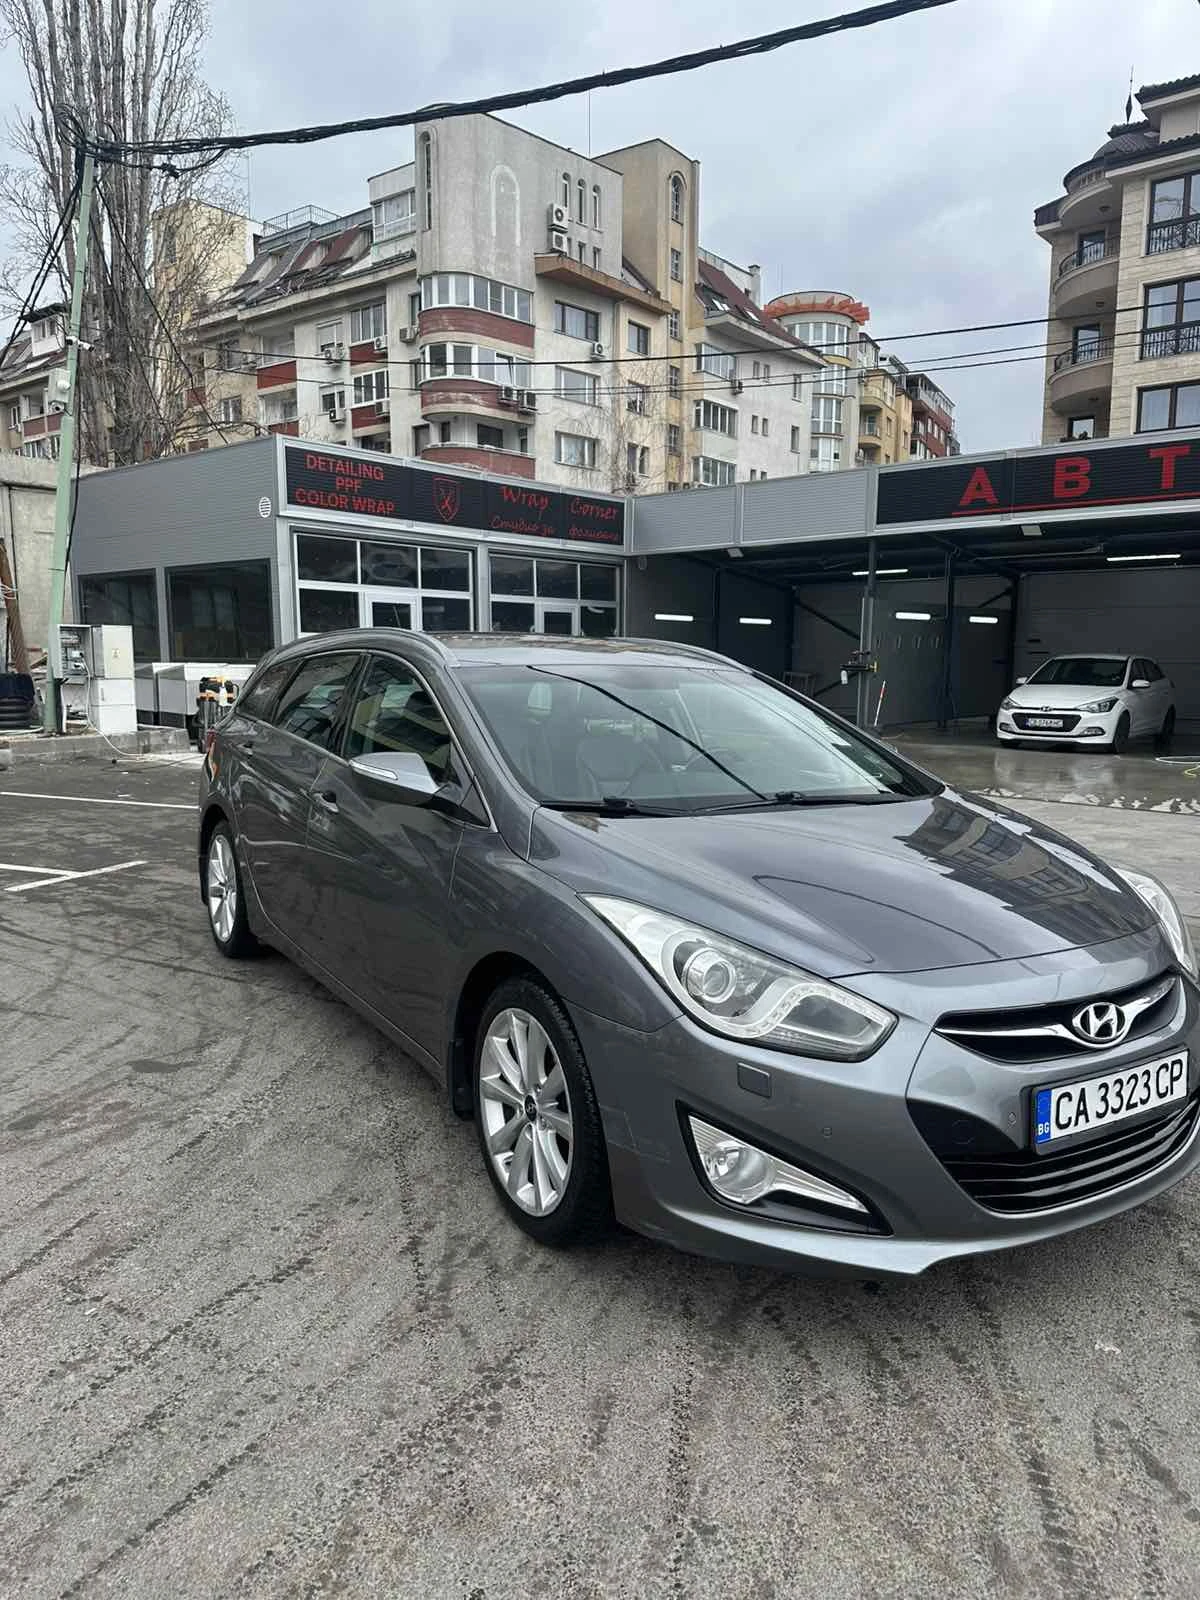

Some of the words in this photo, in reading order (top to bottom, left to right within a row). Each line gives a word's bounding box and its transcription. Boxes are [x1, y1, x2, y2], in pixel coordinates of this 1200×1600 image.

[305, 453, 385, 481] DETAILING
[335, 476, 363, 493] PPF
[294, 488, 349, 510] COLOR
[351, 497, 396, 516] WRAP
[501, 485, 549, 520] Wrap
[571, 497, 618, 520] Corner
[1055, 1088, 1089, 1130] CA
[1095, 1069, 1151, 1119] 3323
[1156, 1058, 1183, 1099] CP
[1037, 1123, 1050, 1135] BG
